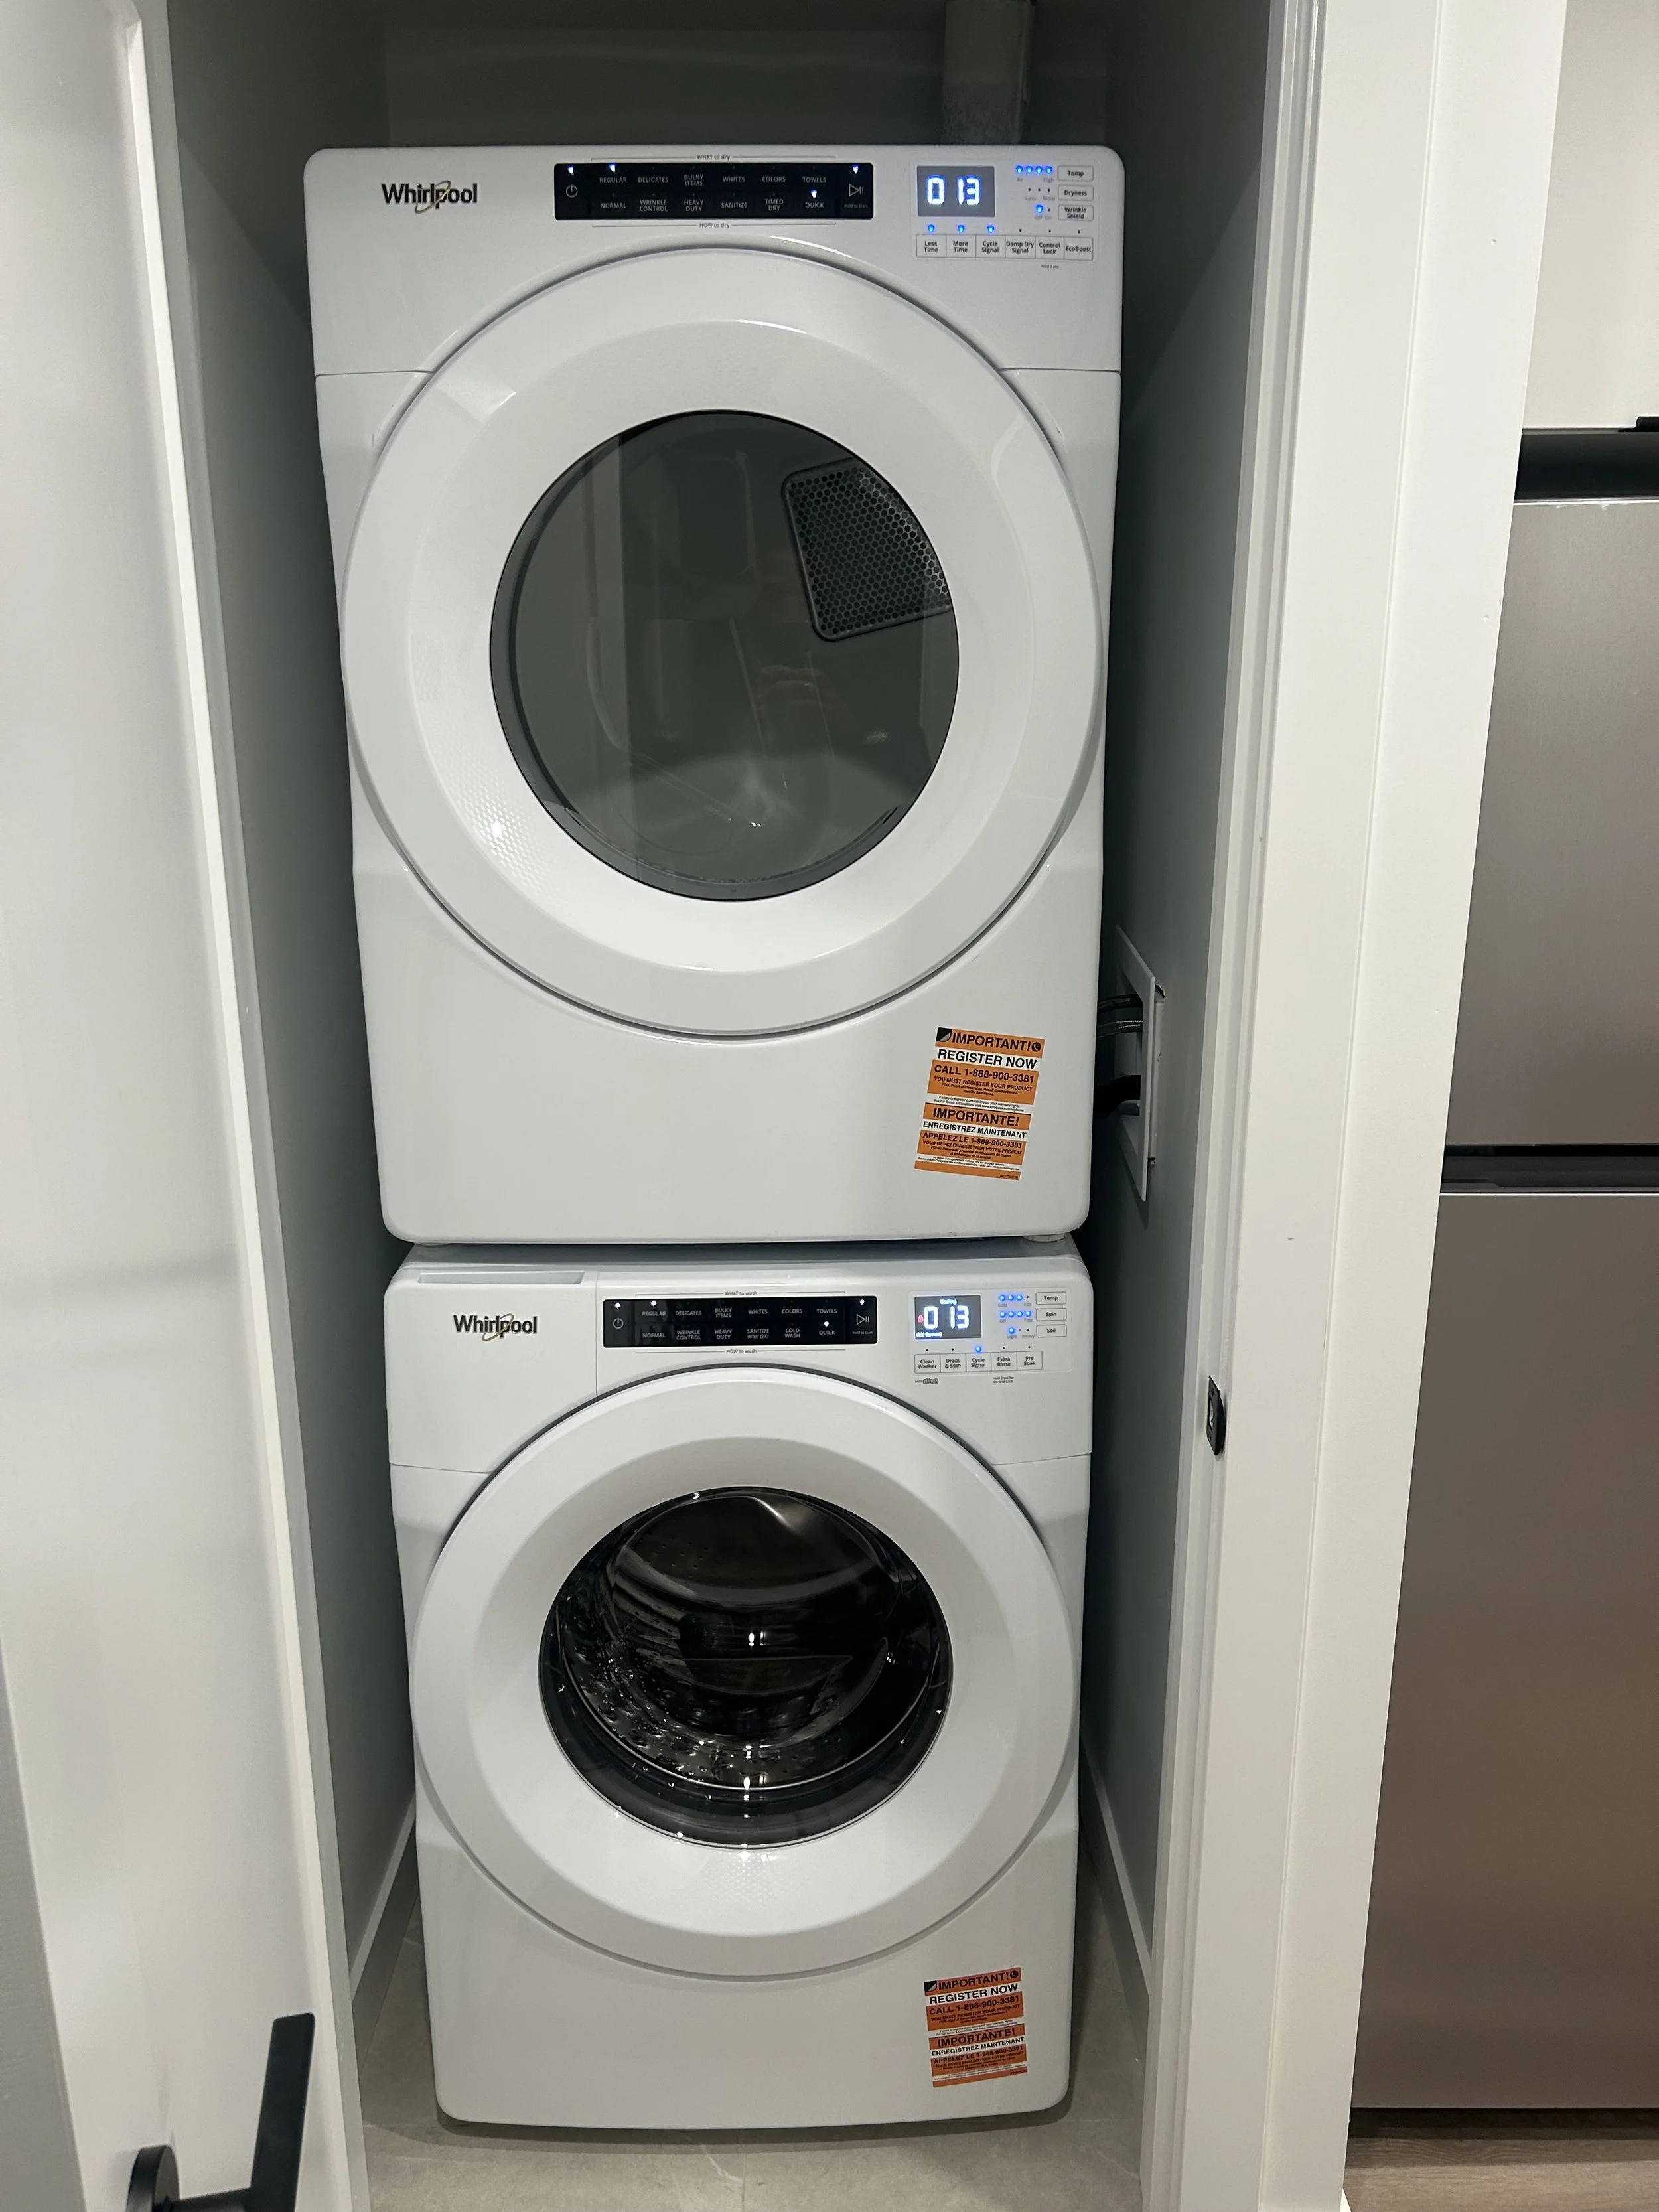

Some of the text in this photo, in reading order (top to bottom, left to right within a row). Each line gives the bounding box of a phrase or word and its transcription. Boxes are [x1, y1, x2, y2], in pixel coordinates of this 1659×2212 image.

[381, 183, 478, 210] Whirlpool
[952, 1032, 1031, 1051] IMPORTANT!
[938, 1049, 1037, 1069] REGISTER NOW
[934, 1065, 1035, 1084] CALL 1-888-900-3381
[932, 1107, 1019, 1127] IMPORTANTE!
[923, 1121, 1027, 1138] ENREGISTREZ MAINTENANT
[922, 1132, 958, 1142] APPELEZ
[970, 1137, 1023, 1149] 1-888-900-3381
[452, 1315, 538, 1339] Whirlpool
[938, 1972, 1009, 1990] IMPORTANT!
[929, 1983, 1018, 2004] REGISTER NOW
[929, 1995, 1020, 2015] CALL 1-888-900-3381
[931, 2037, 1025, 2057] ENREGISTREZ MAINTENANT
[938, 2028, 1015, 2047] IMPORTANTE!
[934, 2054, 964, 2064] APPELEZ
